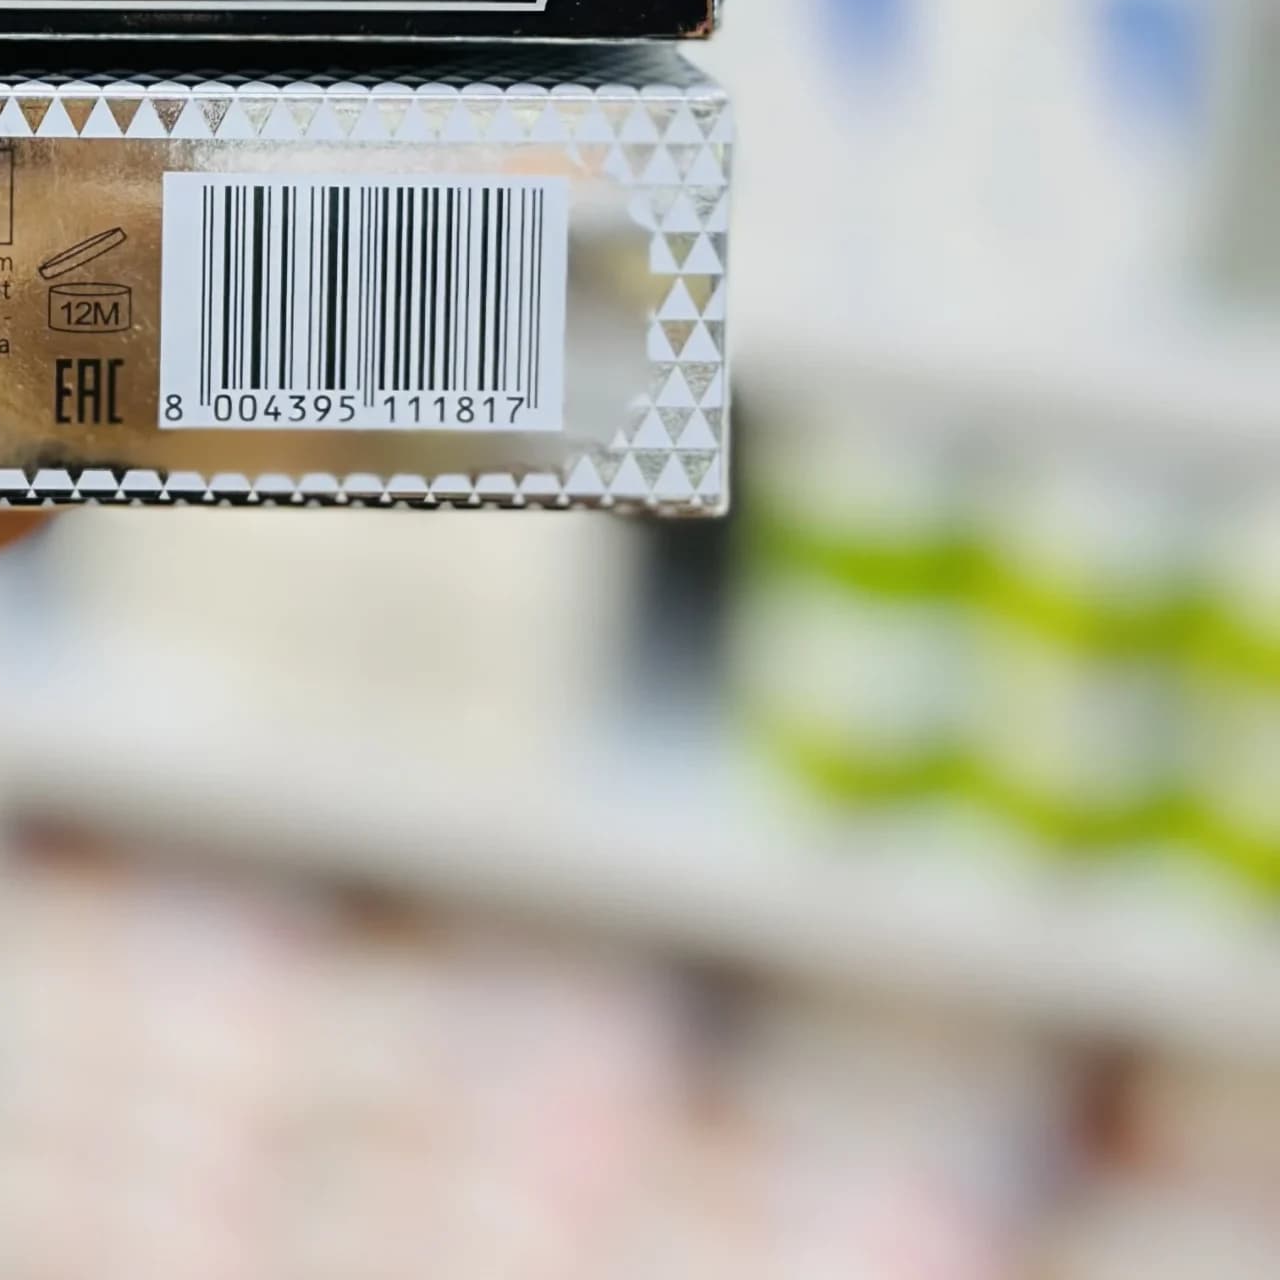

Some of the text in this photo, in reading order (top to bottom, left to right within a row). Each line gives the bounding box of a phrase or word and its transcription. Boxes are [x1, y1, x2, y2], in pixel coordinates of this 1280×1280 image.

[60, 301, 120, 326] 12M
[56, 358, 124, 425] EAC
[164, 394, 524, 424] 8 004395 111817
